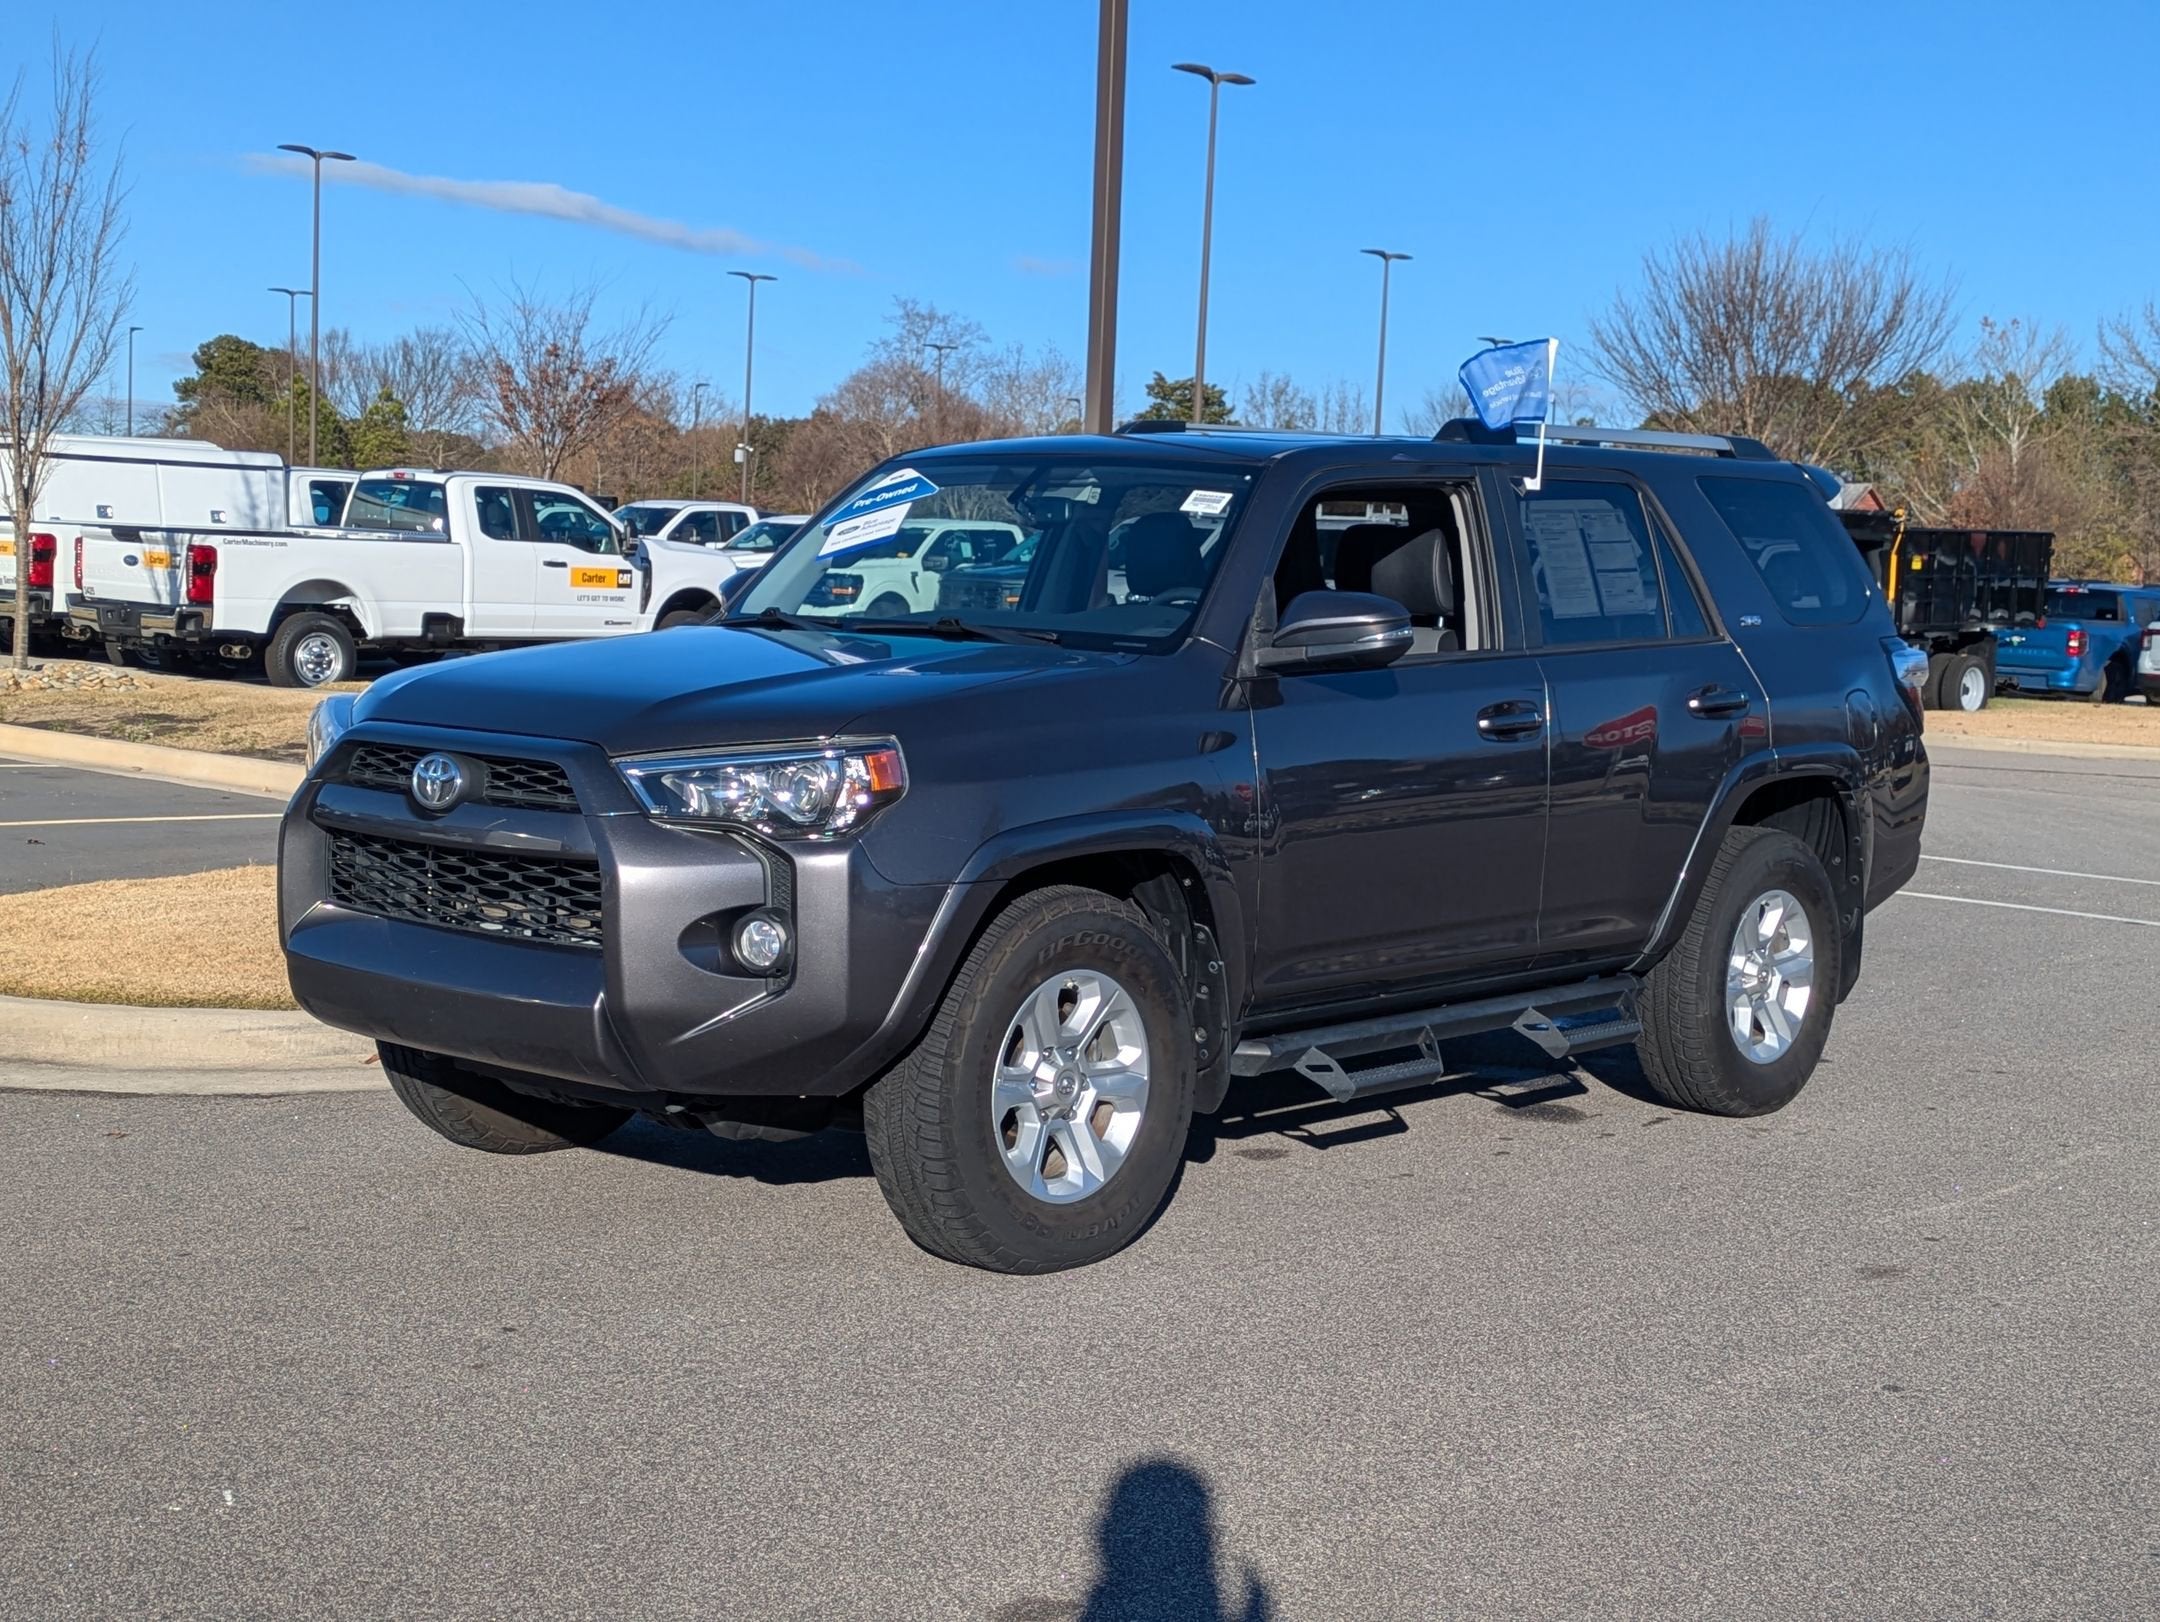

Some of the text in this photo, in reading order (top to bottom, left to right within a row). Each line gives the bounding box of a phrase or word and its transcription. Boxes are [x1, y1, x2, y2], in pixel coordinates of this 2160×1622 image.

[852, 483, 919, 510] Pre-Owned
[223, 537, 288, 548] CarterMachinery.com
[582, 572, 631, 584] Carter CAT
